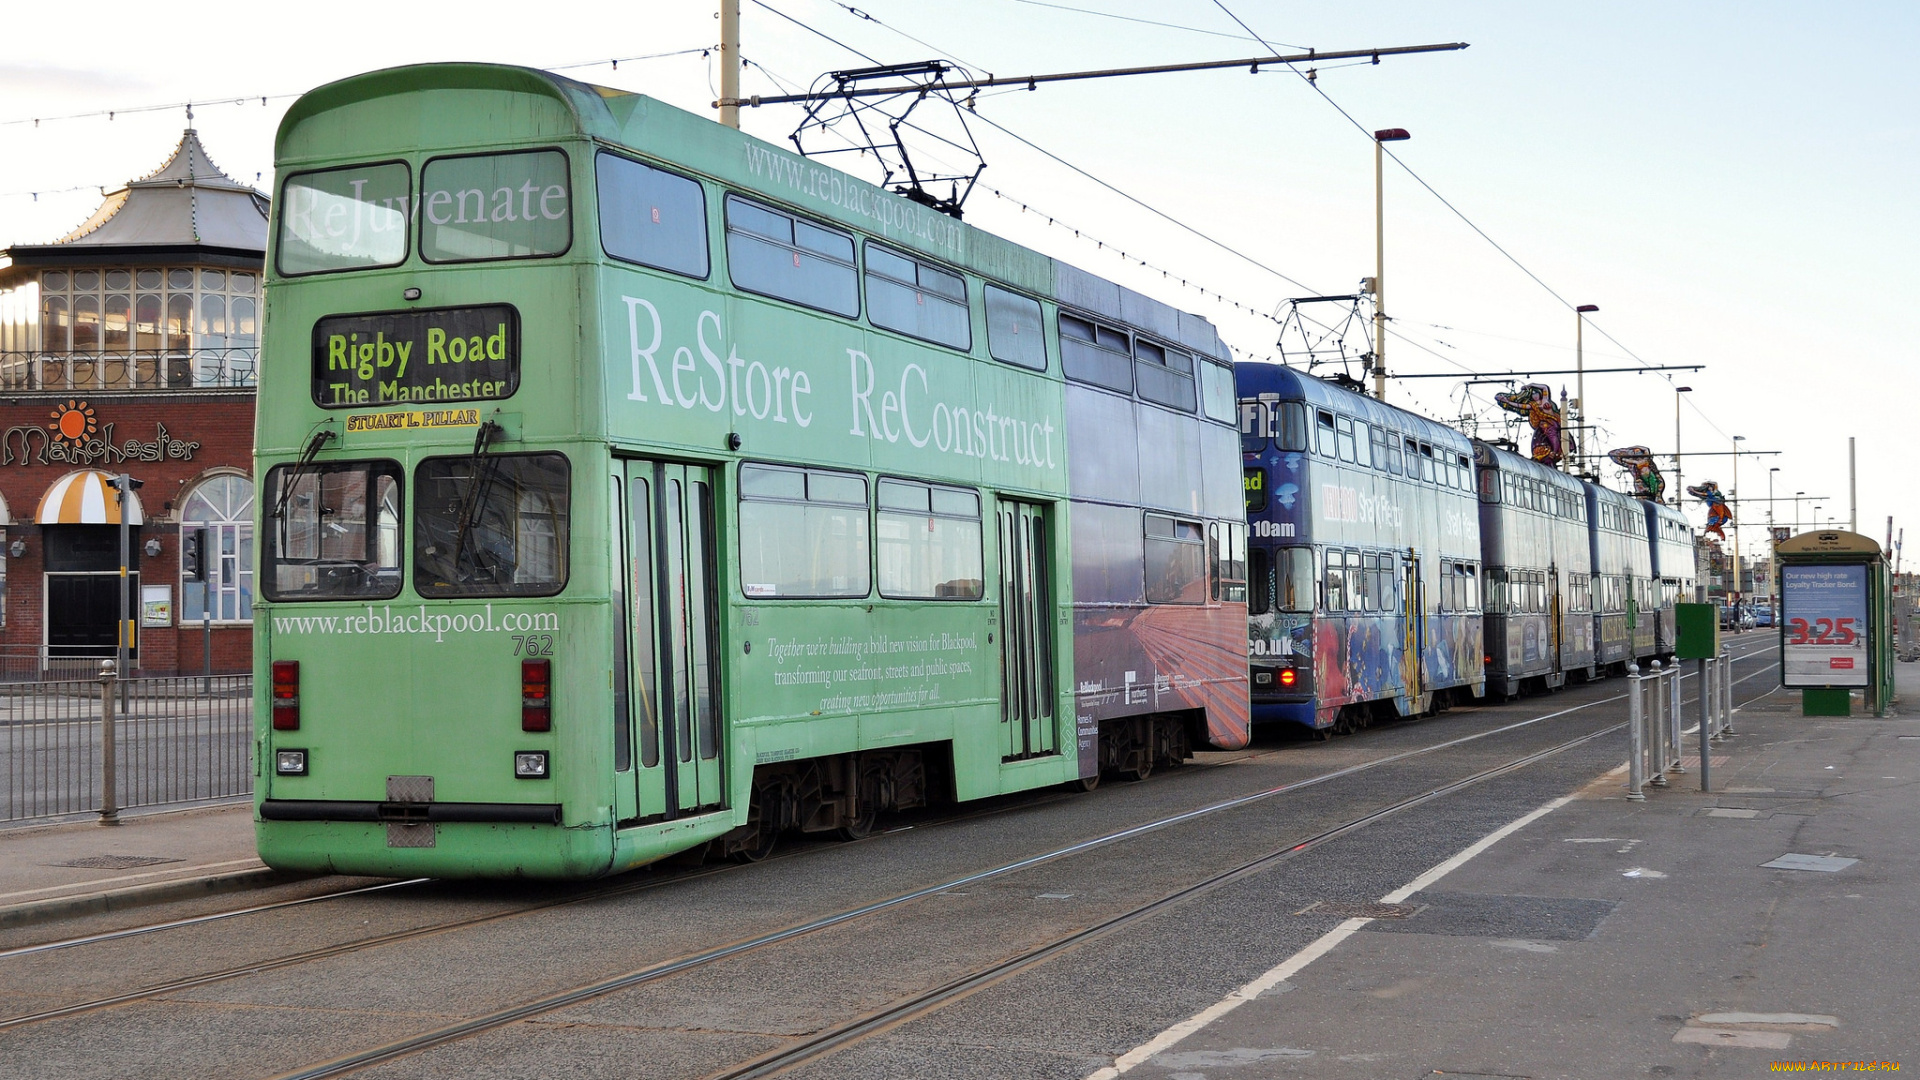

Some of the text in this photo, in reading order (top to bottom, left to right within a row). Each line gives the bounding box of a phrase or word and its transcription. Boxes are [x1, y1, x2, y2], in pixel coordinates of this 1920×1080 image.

[745, 142, 962, 253] www.reblackpool.com
[285, 178, 567, 251] ReJuvenate
[328, 323, 506, 380] Rigby Road
[329, 378, 506, 404] The Manchester
[621, 295, 1056, 471] ReStore ReConstruct
[347, 410, 478, 430] STUART L. PILLAR
[3, 422, 200, 466] Manchester
[1252, 520, 1296, 538] 10am
[1785, 572, 1799, 580] Our
[1817, 572, 1833, 581] high
[1834, 572, 1848, 580] rate
[1785, 581, 1810, 590] Loyalty
[1811, 581, 1834, 589] Tracker
[273, 602, 560, 643] www.reblackpool.com
[1789, 617, 1855, 645] 3.25
[512, 635, 554, 656] 762
[768, 632, 977, 664] Together we're building a bold new vision for Blackpool,
[774, 664, 832, 689] transforming
[833, 668, 847, 682] our
[849, 661, 884, 682] seafront,
[885, 664, 908, 679] streets
[910, 658, 925, 677] and
[926, 657, 948, 682] public
[820, 691, 852, 715] creating
[853, 694, 870, 708] new
[871, 686, 917, 713] opportunities
[917, 684, 929, 708] for
